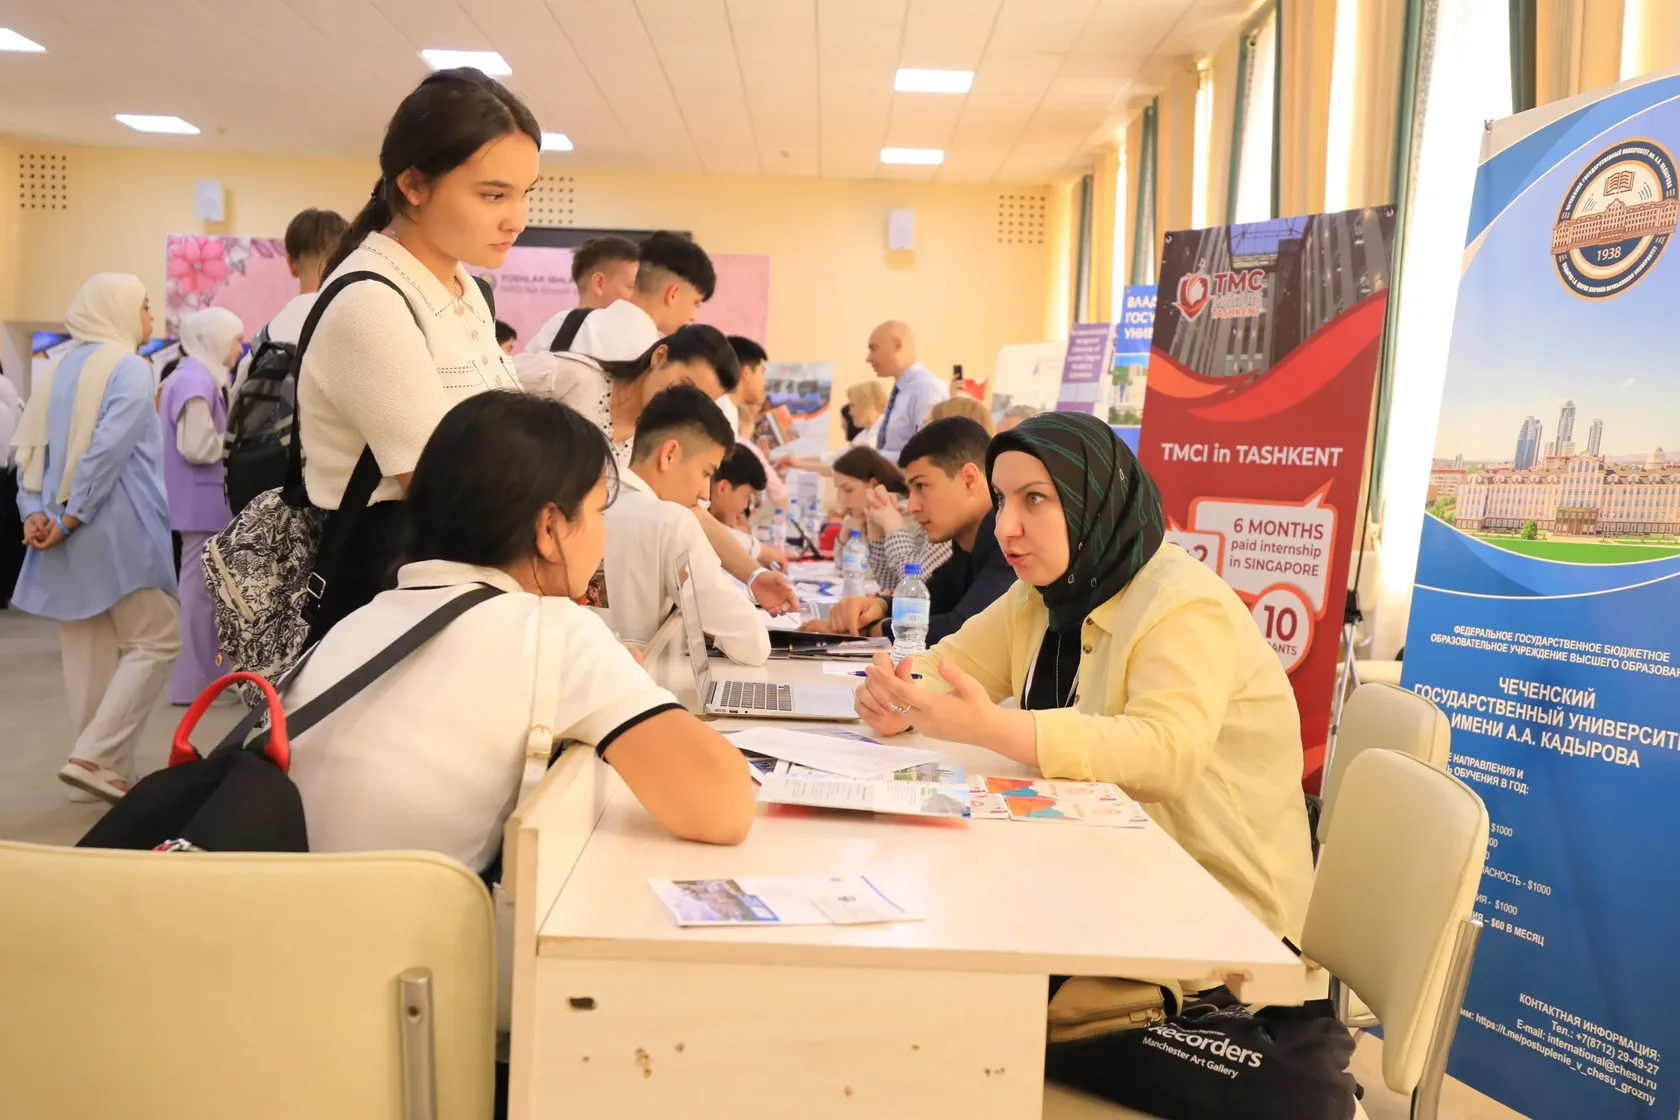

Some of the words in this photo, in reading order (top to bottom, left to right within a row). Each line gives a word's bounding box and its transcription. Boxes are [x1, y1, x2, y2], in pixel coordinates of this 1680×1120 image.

[1596, 246, 1622, 262] 1938
[1214, 269, 1264, 293] TMC
[1161, 443, 1208, 462] TMCI
[1213, 444, 1231, 463] in
[1236, 445, 1343, 466] TASHKENT
[1233, 518, 1244, 533] 6
[1249, 519, 1324, 540] MONTHS
[1231, 538, 1257, 552] paid
[1260, 540, 1321, 560] internship
[1229, 556, 1241, 568] in
[1244, 558, 1319, 577] SINGAPORE
[1263, 605, 1298, 642] 10
[1268, 641, 1297, 656] ANTS
[1430, 633, 1508, 652] ОБРАЗОВАТЕЛЬНОЕ
[1510, 644, 1568, 662] УЧРЕЖДЕНИЕ
[1570, 653, 1619, 669] ВЫСШЕГО
[1454, 625, 1513, 642] ФЕДЕРАЛЬНОЕ
[1515, 632, 1602, 653] ГОСУДАРСТВЕННОЕ
[1604, 644, 1670, 662] БЮДЖЕТНОЕ
[1499, 676, 1596, 709] ЧЕЧЕНСКИЙ
[1414, 683, 1564, 728] ГОСУДАРСТВЕННЫЙ
[1568, 712, 1680, 751] УНИВЕРСИТ
[1451, 713, 1504, 738] ИМЕНИ
[1506, 727, 1536, 745] А.А.
[1540, 732, 1640, 768] КАДЫРОВА
[1453, 752, 1516, 777] НАПРАВЛЕНИЯ
[1517, 769, 1524, 779] И
[1454, 767, 1499, 787] ОБУЧЕНИЯ
[1501, 779, 1507, 788] В
[1509, 781, 1530, 796] ГОД:
[1491, 822, 1513, 837] $1000
[1527, 880, 1551, 896] $1000
[1495, 900, 1518, 916] $1000
[1491, 918, 1504, 930] $60
[1506, 923, 1512, 933] В
[1514, 926, 1545, 947] МЕСЯЦ
[1519, 993, 1580, 1027] КОНТАКТНАЯ
[1583, 1016, 1660, 1062] ИНФОРМАЦИЯ:
[1142, 1036, 1190, 1060] Manchester
[1190, 1055, 1206, 1067] Art
[1206, 1060, 1239, 1079] Gallery
[1475, 1012, 1656, 1106] https://t.me/postuplenie_v_chesu_grozny
[1516, 1018, 1545, 1040] E-mail:
[1547, 1032, 1657, 1090] international@chesu.ru
[1552, 1020, 1573, 1039] Тел.:
[1576, 1032, 1616, 1059] +7(8712)
[1617, 1049, 1659, 1076] 29-49-27
